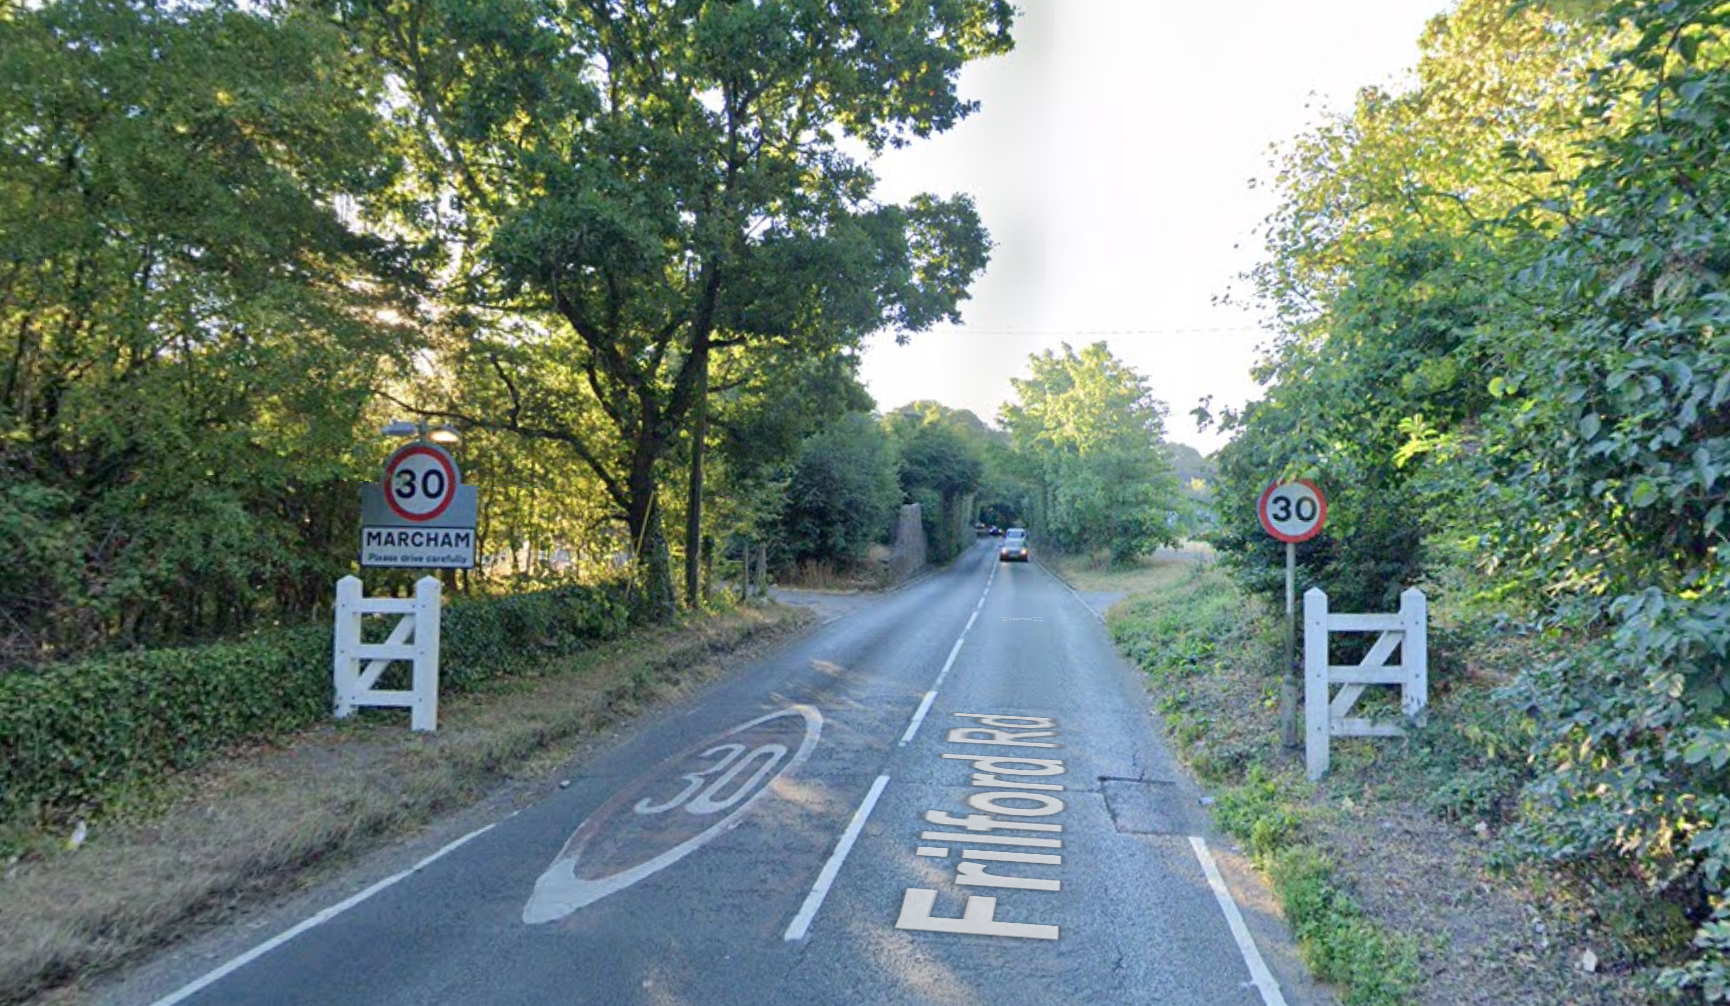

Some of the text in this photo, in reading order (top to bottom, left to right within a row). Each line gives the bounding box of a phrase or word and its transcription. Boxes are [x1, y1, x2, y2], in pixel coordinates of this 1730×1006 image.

[395, 469, 445, 499] 30
[1272, 495, 1317, 522] 30
[366, 531, 470, 547] MARCHAM
[368, 553, 467, 564] Please drive carefully
[634, 743, 788, 815] 30
